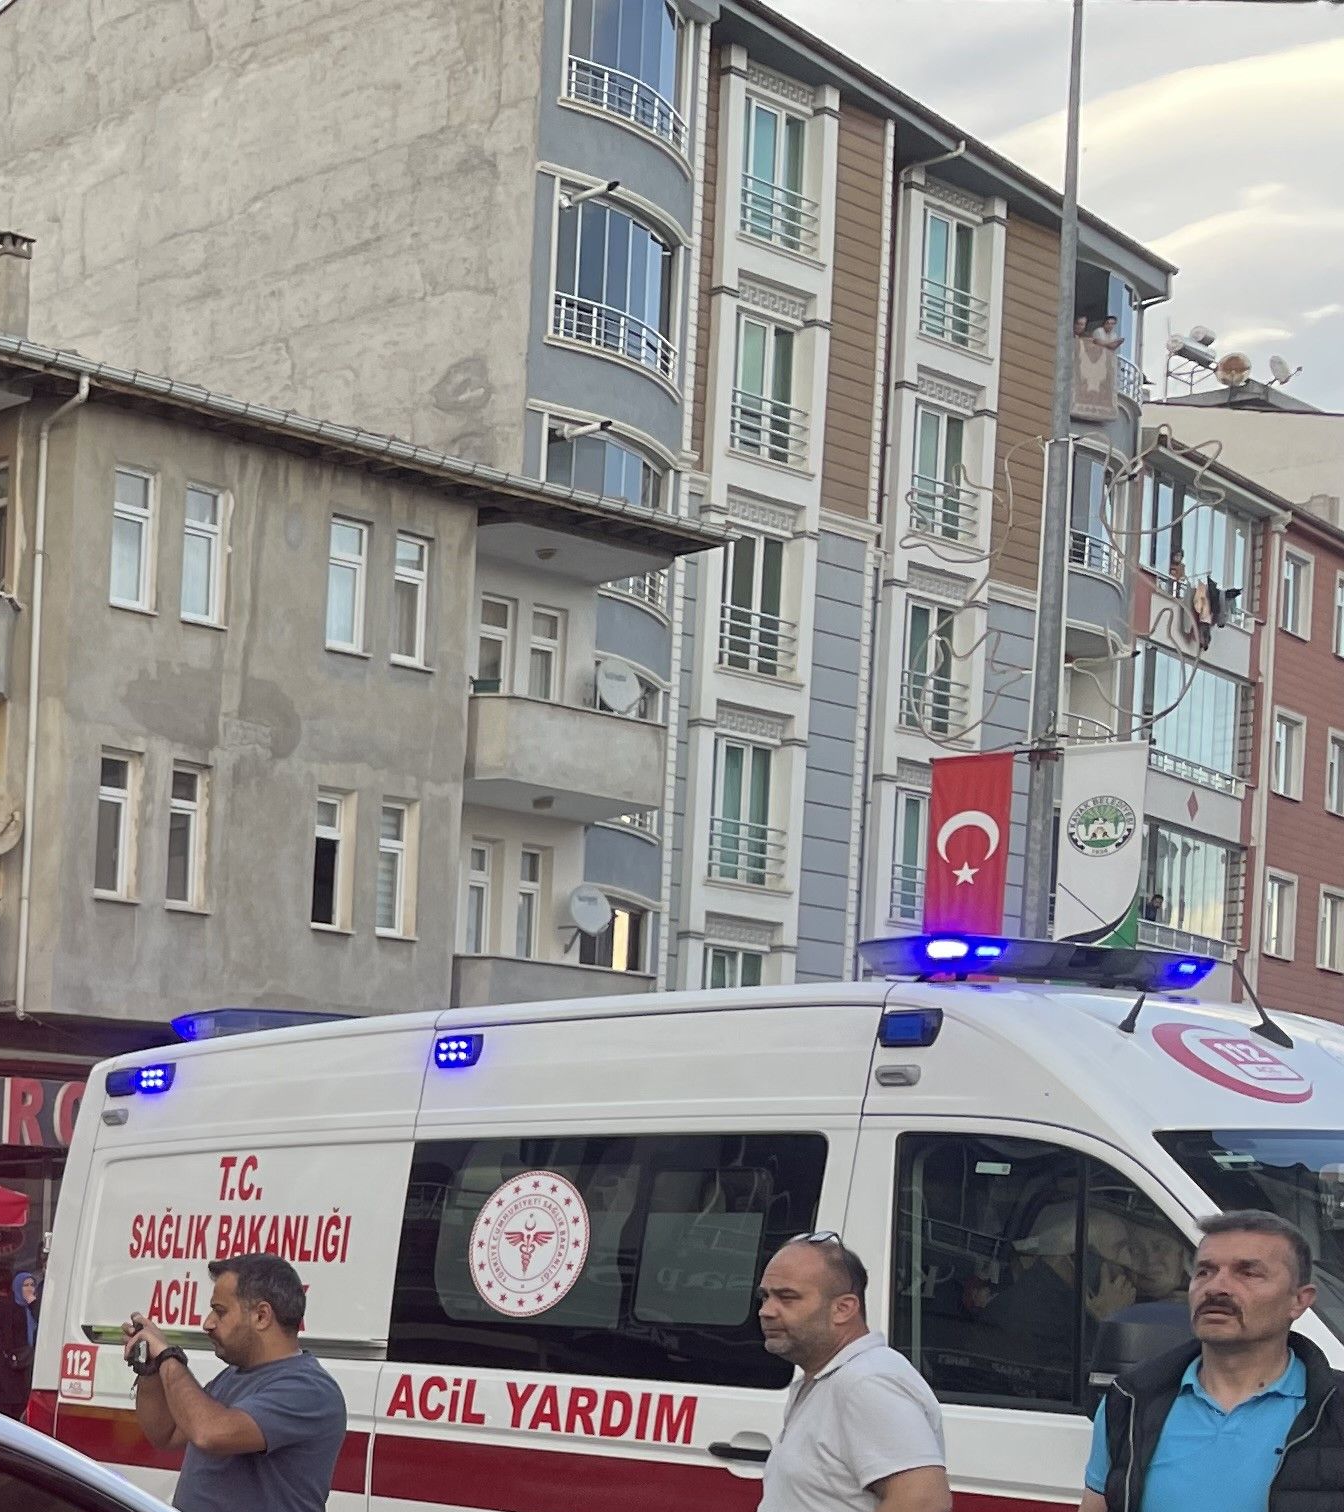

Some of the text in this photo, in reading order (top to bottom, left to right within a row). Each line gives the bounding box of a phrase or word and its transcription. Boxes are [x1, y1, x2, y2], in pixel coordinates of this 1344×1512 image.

[1213, 1042, 1273, 1063] 112
[219, 1155, 263, 1201] T.C.
[129, 1207, 352, 1263] SAĞLIK BAKANLIĞI
[147, 1271, 202, 1326] ACİL
[66, 1349, 91, 1377] 112
[507, 1381, 699, 1446] YARDIM
